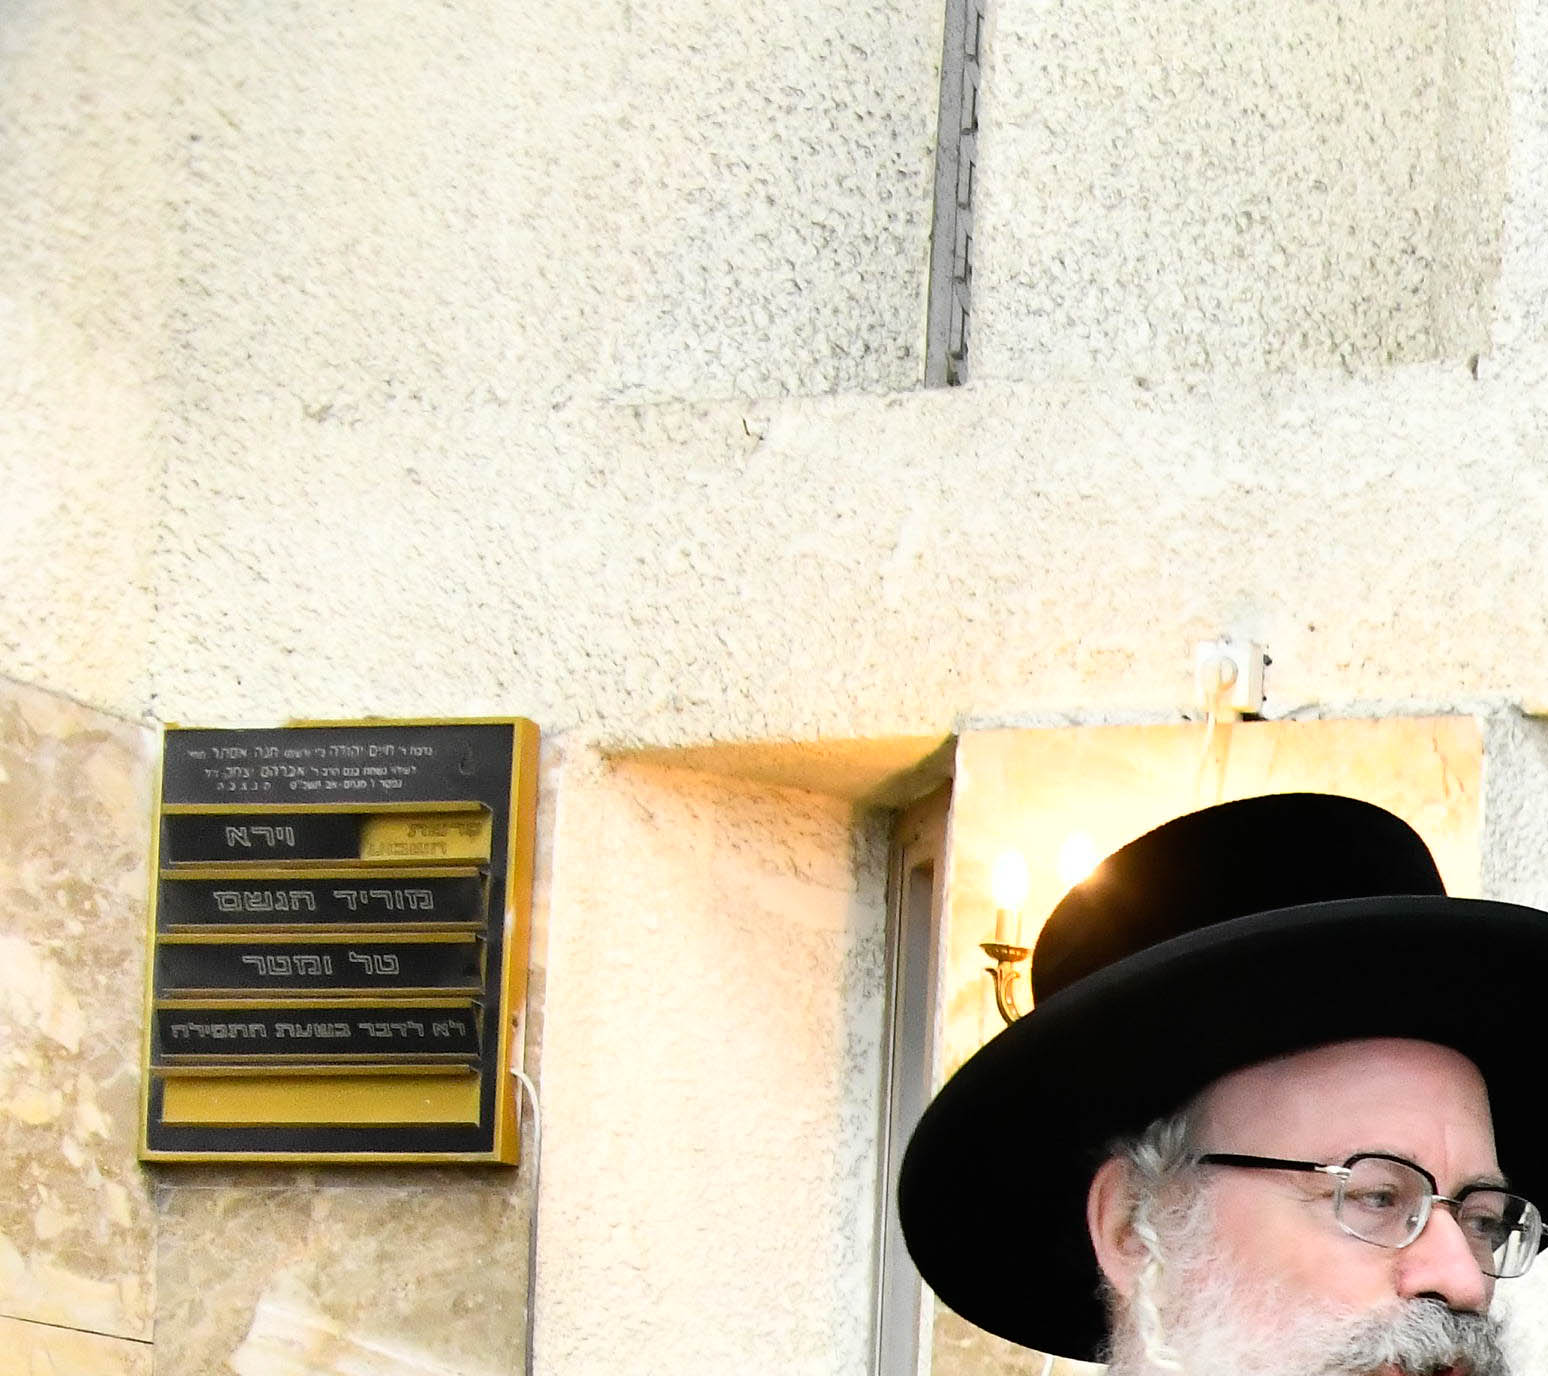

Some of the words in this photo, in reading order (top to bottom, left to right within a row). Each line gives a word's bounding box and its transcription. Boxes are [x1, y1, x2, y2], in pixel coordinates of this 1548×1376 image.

[225, 825, 296, 847] וירא
[212, 889, 317, 912] הגשם
[332, 888, 435, 911] מוריד
[241, 953, 334, 977] ומטר
[349, 951, 400, 976] טל
[169, 1020, 267, 1040] התפילה
[274, 1021, 351, 1039] בשעת
[358, 1020, 425, 1038] לדבר
[432, 1018, 467, 1038] לא
